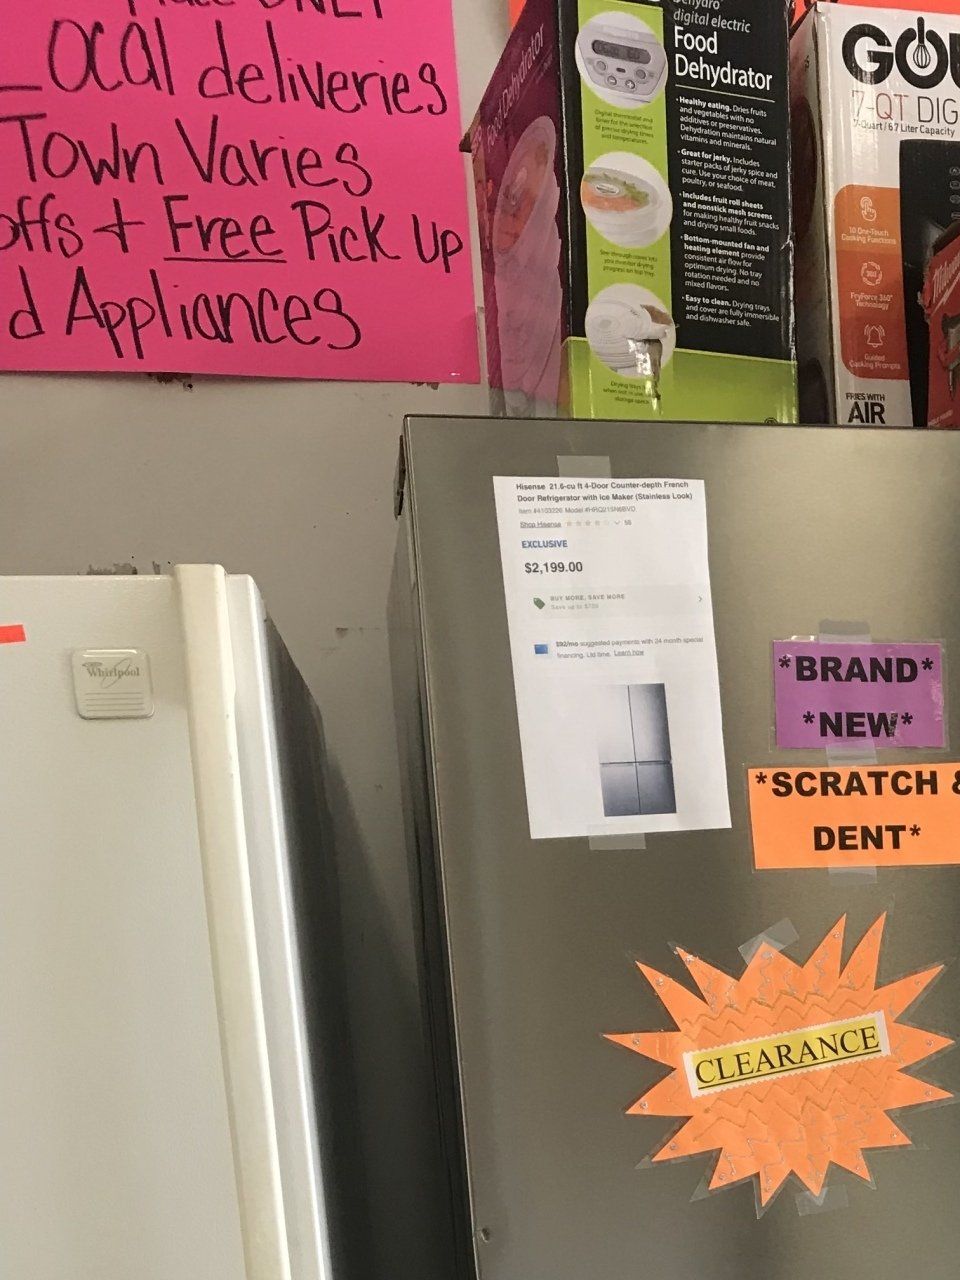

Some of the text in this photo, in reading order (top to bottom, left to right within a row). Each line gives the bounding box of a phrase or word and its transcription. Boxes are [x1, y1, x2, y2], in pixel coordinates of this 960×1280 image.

[673, 8, 750, 33] digital electric
[674, 25, 717, 54] Food
[0, 18, 174, 96] ocal
[198, 19, 448, 115] deliveries
[503, 23, 543, 119] Dehydrator
[675, 53, 773, 91] Dehydrator
[679, 96, 767, 117] Healthy eating. Dries fruits
[680, 106, 692, 114] and
[694, 109, 729, 120] vegetables
[730, 114, 745, 122] with
[852, 90, 909, 121] 7-QT
[680, 115, 709, 125] additives
[680, 123, 776, 145] Dehydration maintains natural
[681, 134, 708, 144] vitamins
[710, 138, 722, 146] and
[900, 124, 918, 133] Liter
[919, 125, 955, 138] Capacity
[0, 113, 373, 197] Town Varies
[681, 148, 760, 167] Great for jerky. Includes
[682, 159, 702, 167] starter
[704, 161, 722, 170] packs
[731, 166, 747, 175] jerky
[748, 169, 764, 178] spice
[765, 171, 778, 179] and
[728, 174, 749, 183] choice
[164, 194, 284, 260] Free
[291, 199, 402, 263] Pick
[412, 213, 464, 273] Up
[65, 266, 362, 359] Appliances
[867, 393, 885, 401] WITH
[848, 401, 885, 424] AIR
[611, 482, 662, 490] Counter-depth
[537, 494, 580, 503] Refrigerator
[612, 493, 633, 501] Maker
[635, 493, 670, 501] (Stainless
[672, 492, 693, 500] Look)
[521, 540, 568, 548] EXCLUSIVE
[524, 562, 583, 575] $2,199.00
[82, 661, 140, 679] Whirlpool
[694, 1024, 880, 1085] CLEARANCE
